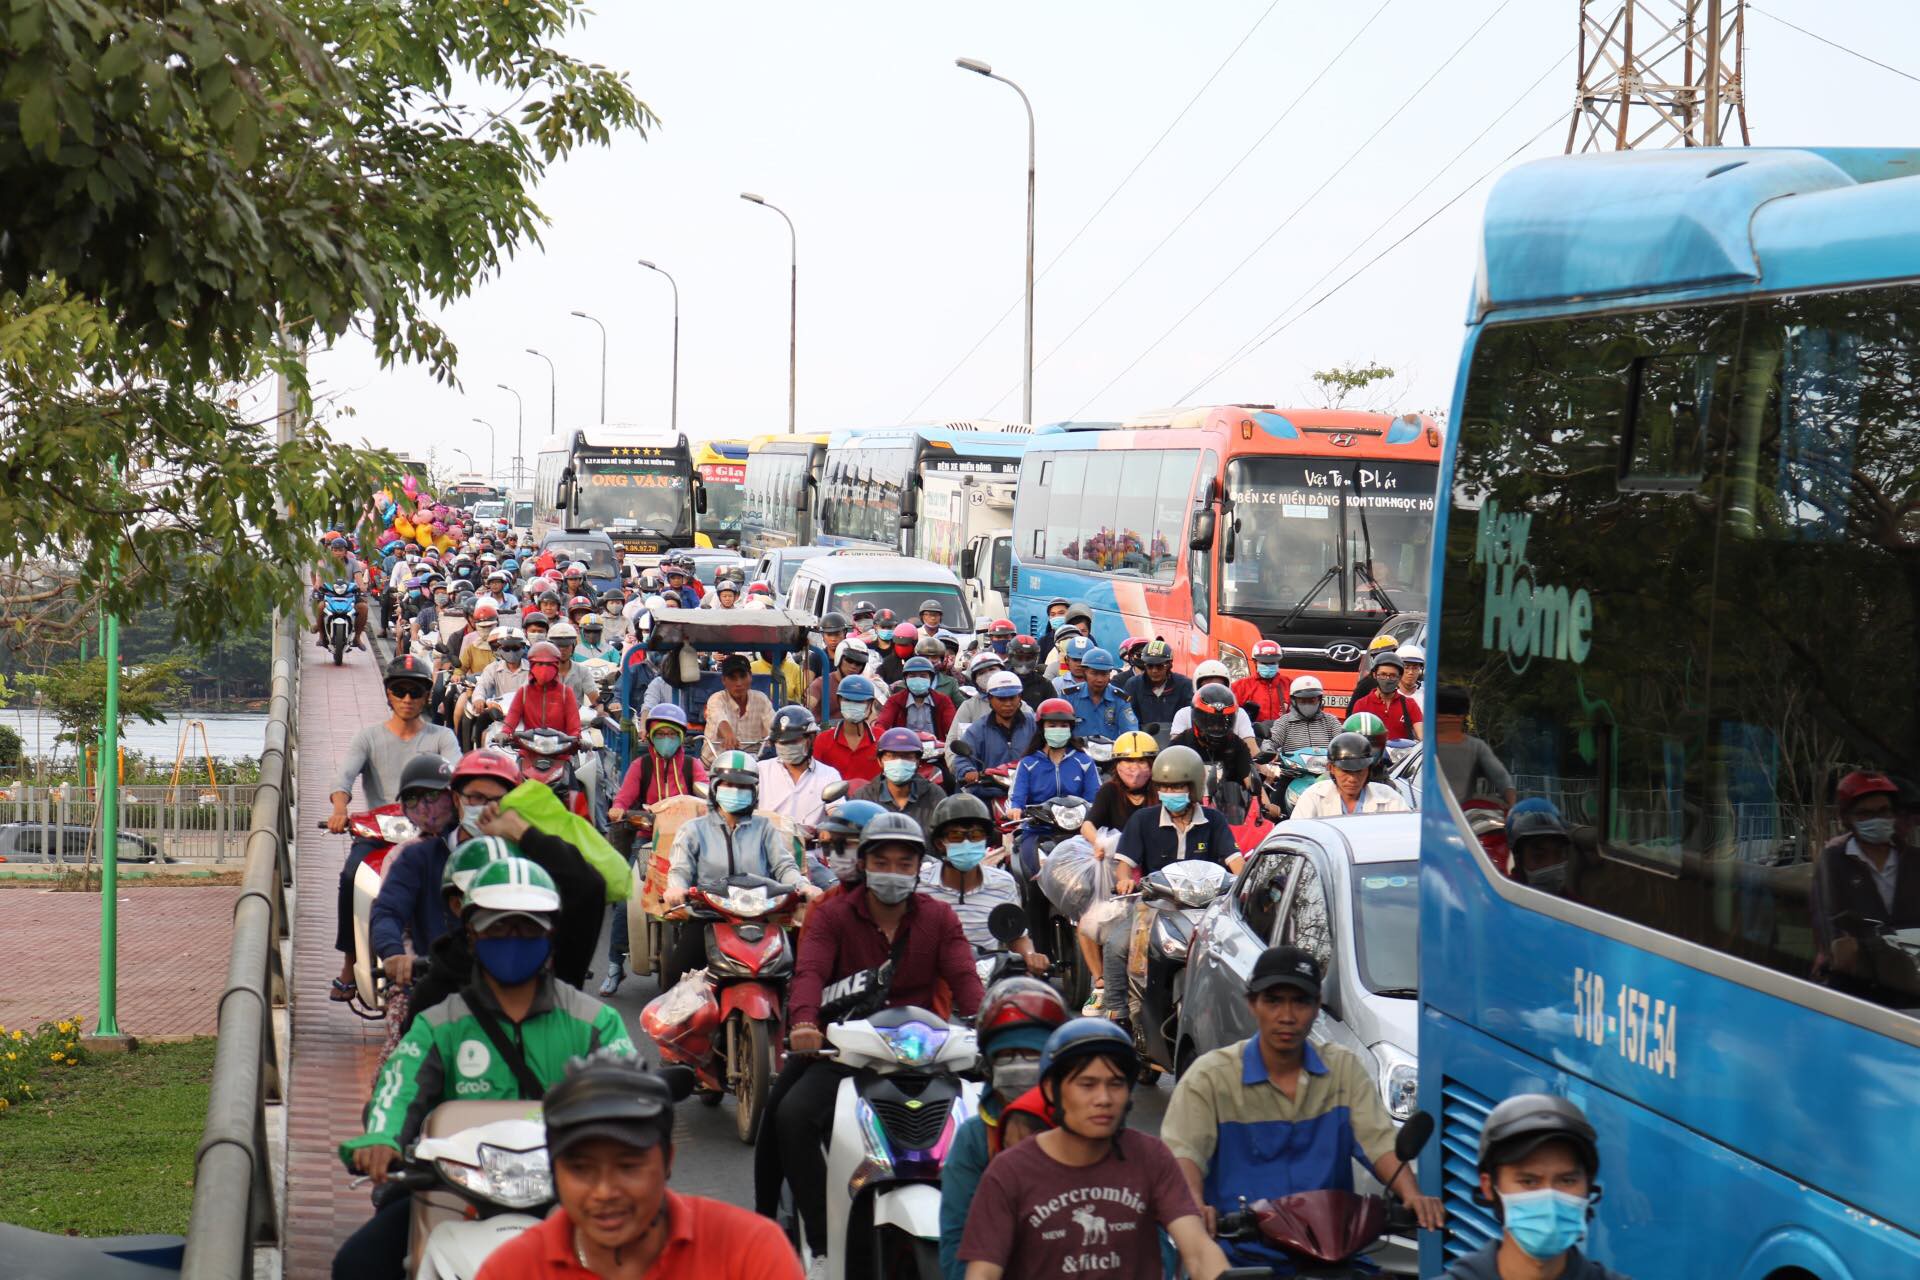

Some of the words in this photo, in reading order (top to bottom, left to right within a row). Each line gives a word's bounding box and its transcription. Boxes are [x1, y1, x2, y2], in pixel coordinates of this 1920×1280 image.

[937, 461, 949, 471] BẾN
[975, 462, 992, 472] ĐÔNG
[972, 494, 982, 502] 14
[1238, 489, 1259, 503] BẾN
[1262, 493, 1276, 503] XE
[1279, 489, 1305, 505] MIỀN
[1308, 493, 1340, 506] ĐÔNG
[1475, 499, 1533, 565] New
[1482, 562, 1592, 673] Home
[456, 1079, 490, 1094] Grab
[1028, 1186, 1147, 1228] abercrombie
[1042, 1228, 1067, 1240] NEW
[1108, 1222, 1136, 1232] YORK
